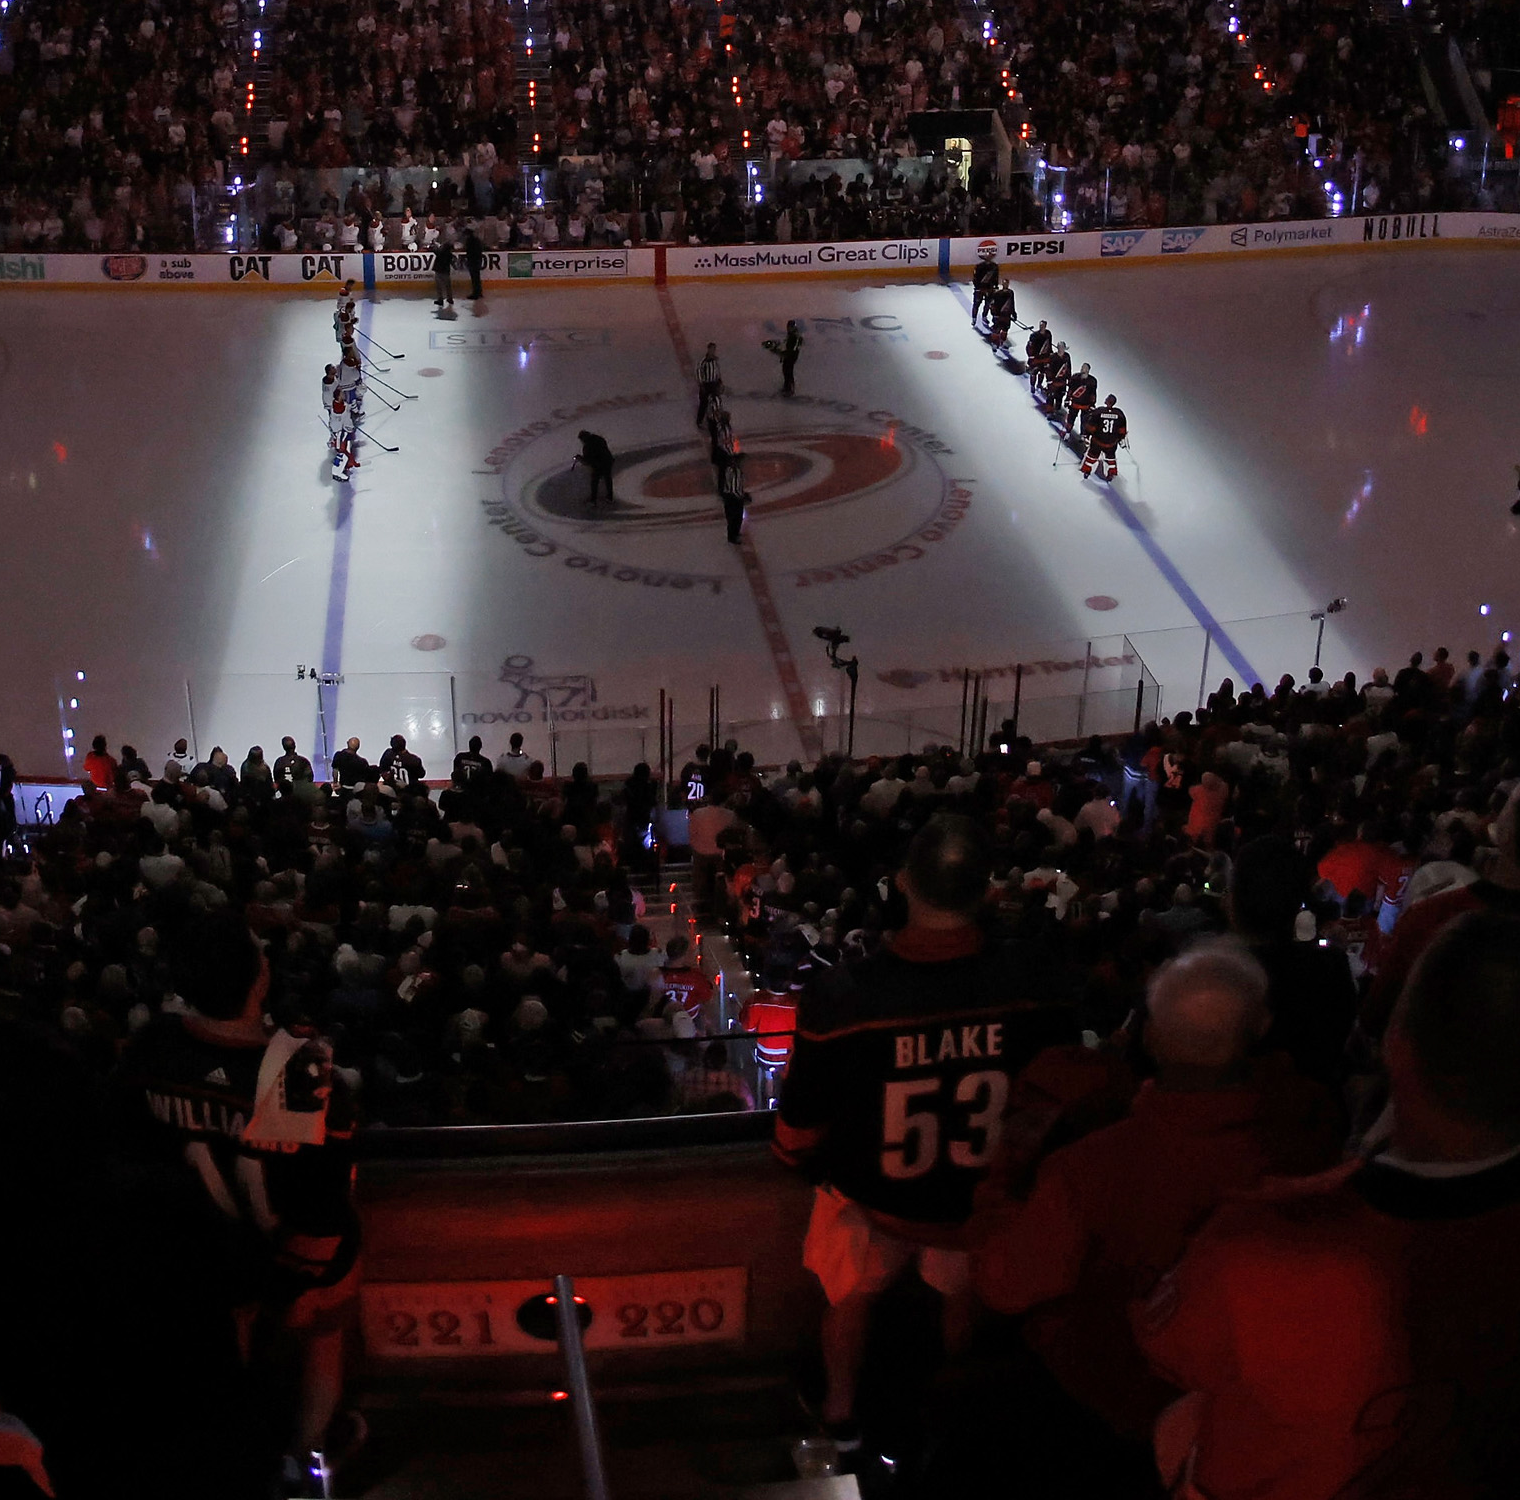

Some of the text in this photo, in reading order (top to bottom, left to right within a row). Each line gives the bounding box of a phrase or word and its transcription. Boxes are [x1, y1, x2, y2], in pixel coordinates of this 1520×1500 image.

[1254, 225, 1333, 245] Polymarket
[1363, 215, 1441, 241] NOBULL
[1006, 239, 1065, 256] PEPSI
[1101, 234, 1134, 255] SAP
[1162, 229, 1196, 251] SAP
[171, 258, 192, 268] sub
[518, 257, 625, 273] enterprise
[713, 251, 812, 268] MassMutual
[817, 244, 929, 265] Great Clips
[159, 269, 195, 279] above
[229, 255, 271, 281] CAT
[301, 255, 344, 281] CAT
[1102, 419, 1115, 434] 31
[461, 703, 650, 725] novo nordisk
[687, 781, 704, 800] 20
[894, 1022, 1005, 1069] BLAKE
[144, 1088, 247, 1139] WILLIA
[879, 1069, 1010, 1182] 53
[383, 1309, 495, 1348] 221
[618, 1298, 725, 1338] 220
